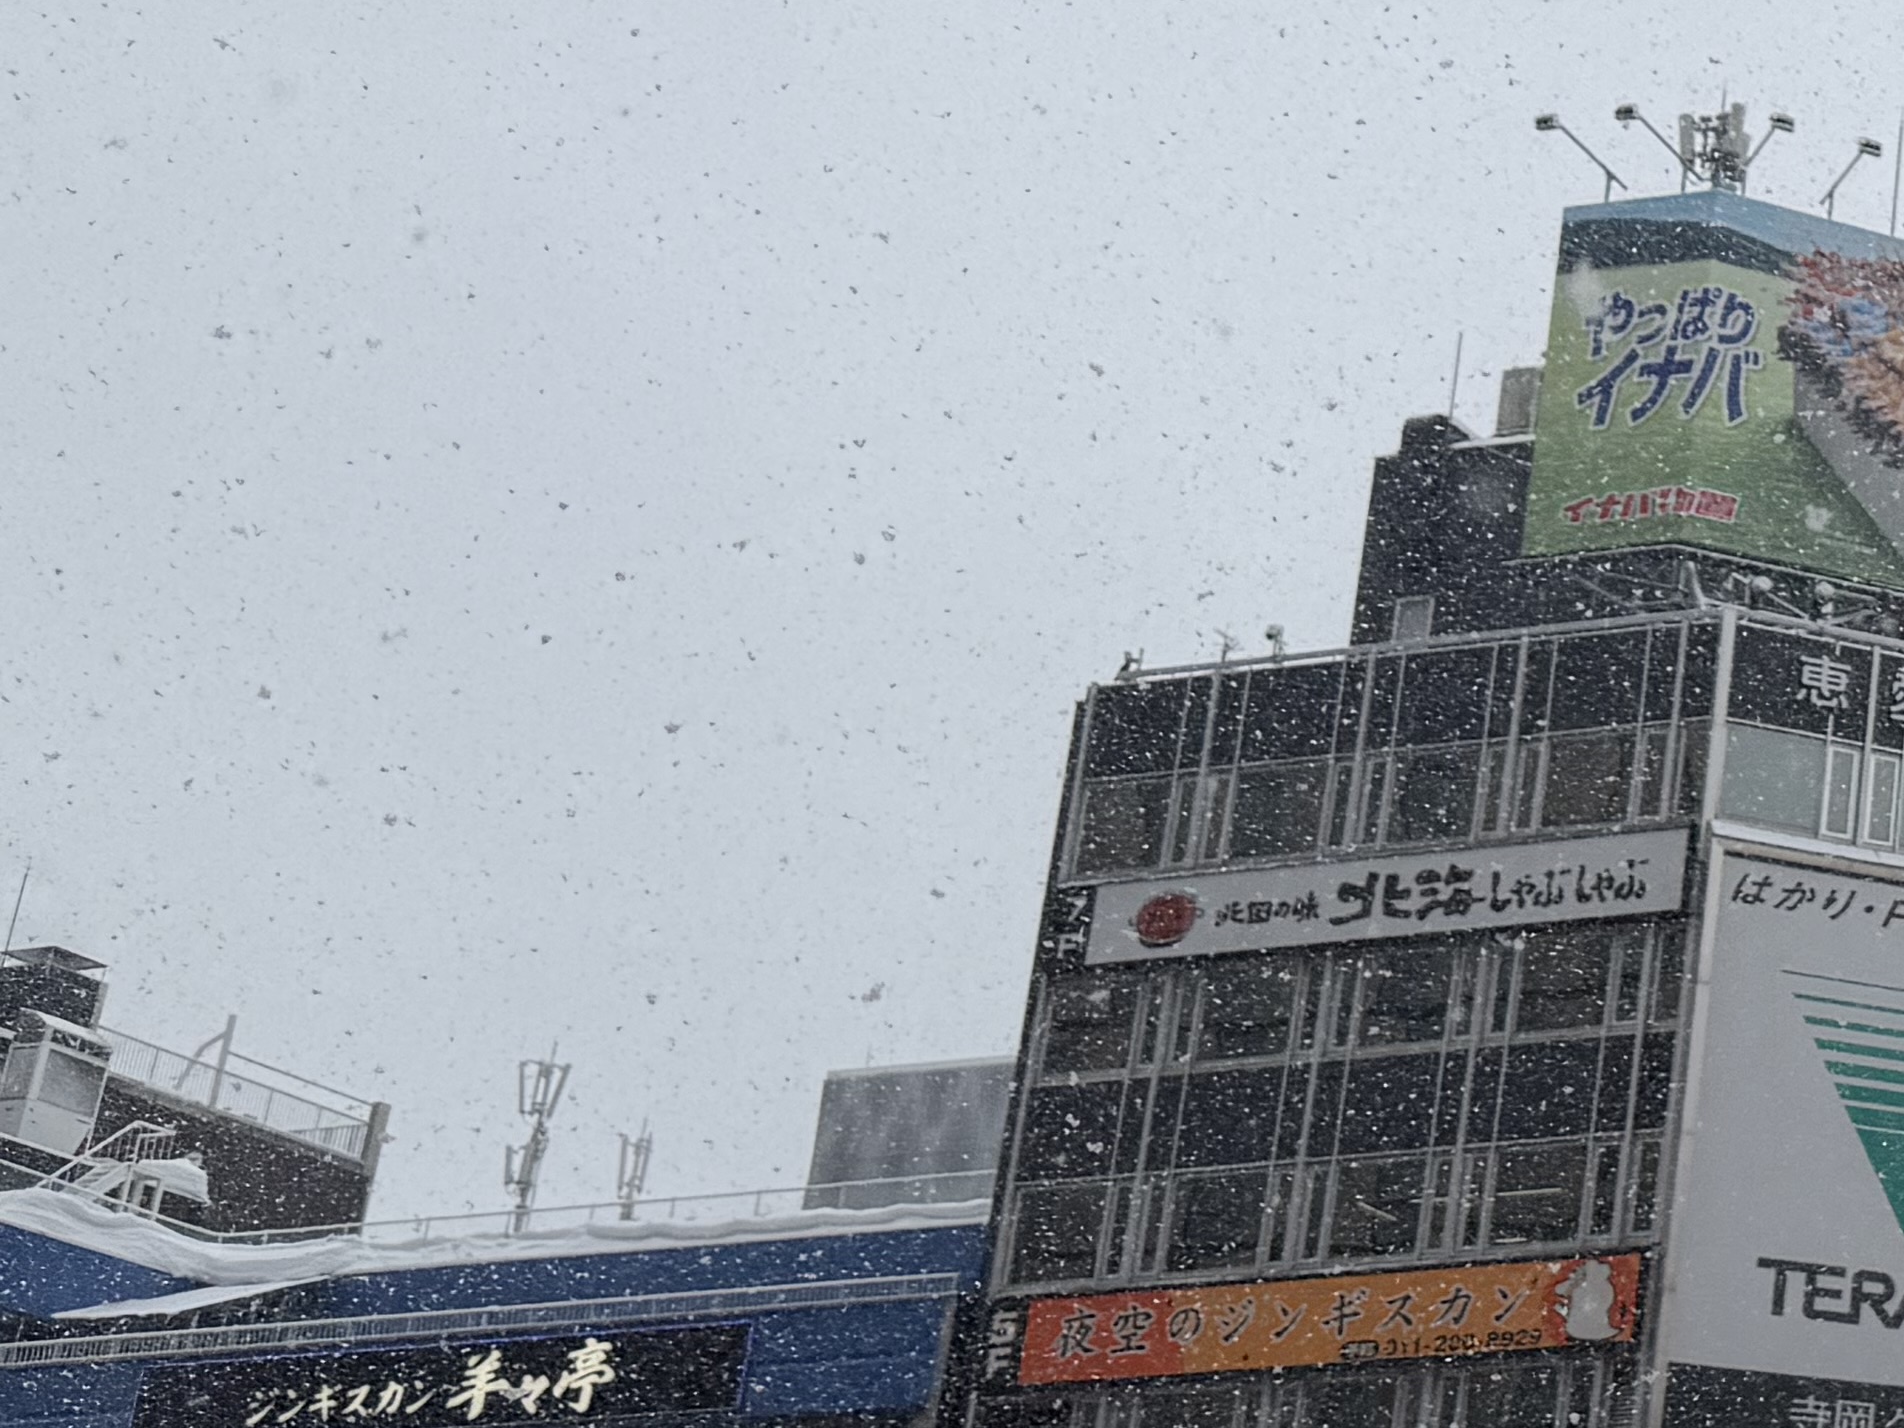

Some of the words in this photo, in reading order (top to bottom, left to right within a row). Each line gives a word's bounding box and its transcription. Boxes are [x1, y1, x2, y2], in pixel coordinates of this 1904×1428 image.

[1584, 285, 1765, 358] やっぱり
[1576, 344, 1765, 430] イナバ
[1055, 1287, 1532, 1361] 夜空のジンギスカン
[245, 1377, 435, 1428] ジンギスカン
